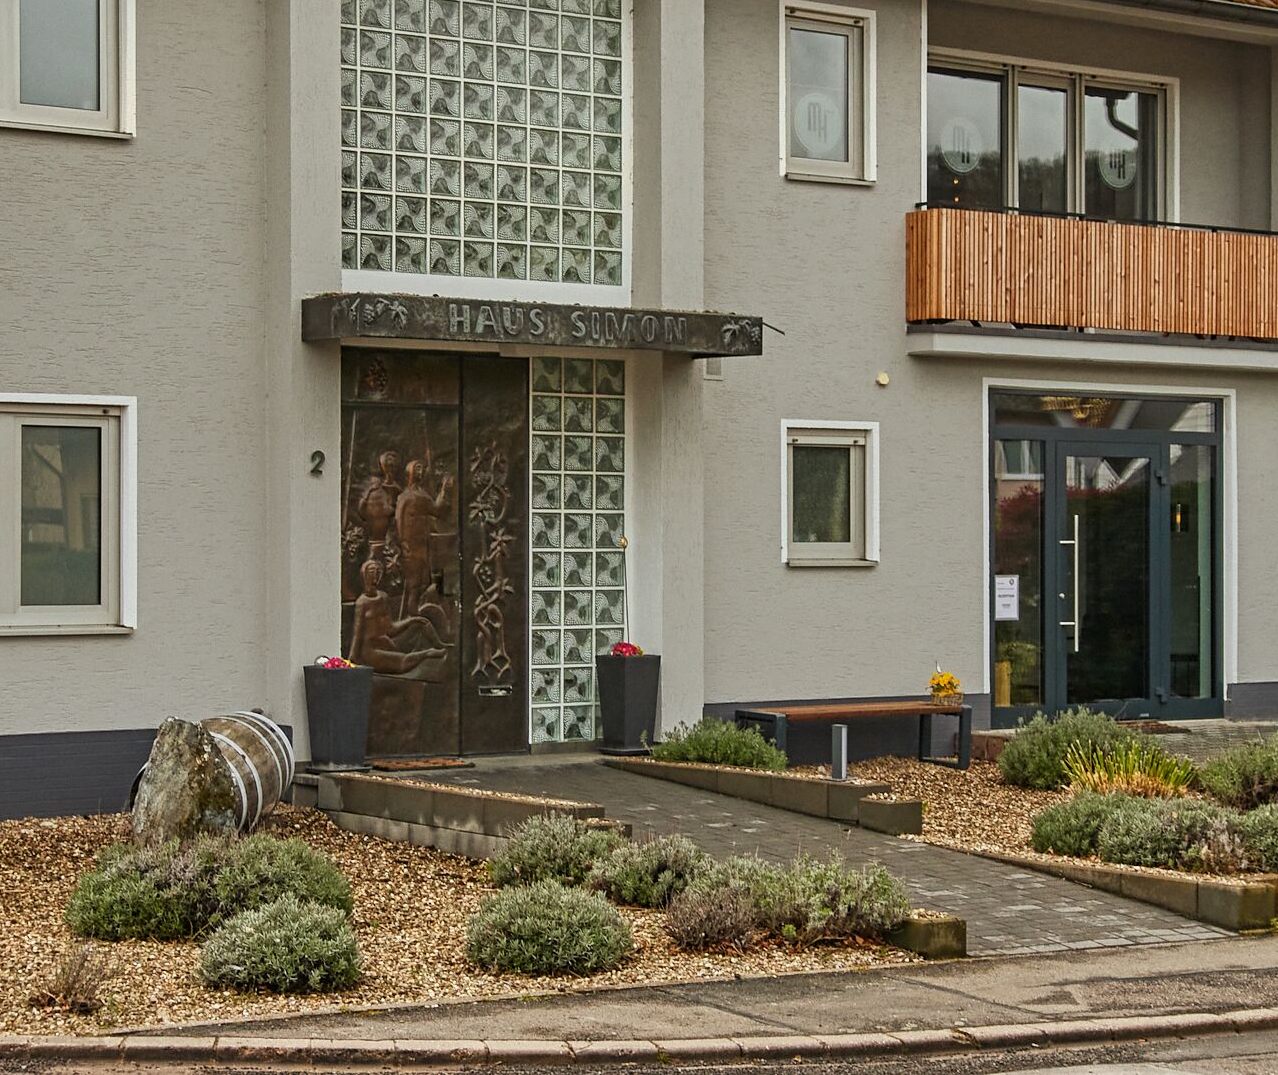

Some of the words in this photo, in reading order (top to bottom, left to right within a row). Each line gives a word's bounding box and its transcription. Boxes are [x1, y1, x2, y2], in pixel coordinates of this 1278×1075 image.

[448, 302, 544, 336] HAUS
[570, 310, 688, 344] SIMON
[310, 450, 326, 477] 2
